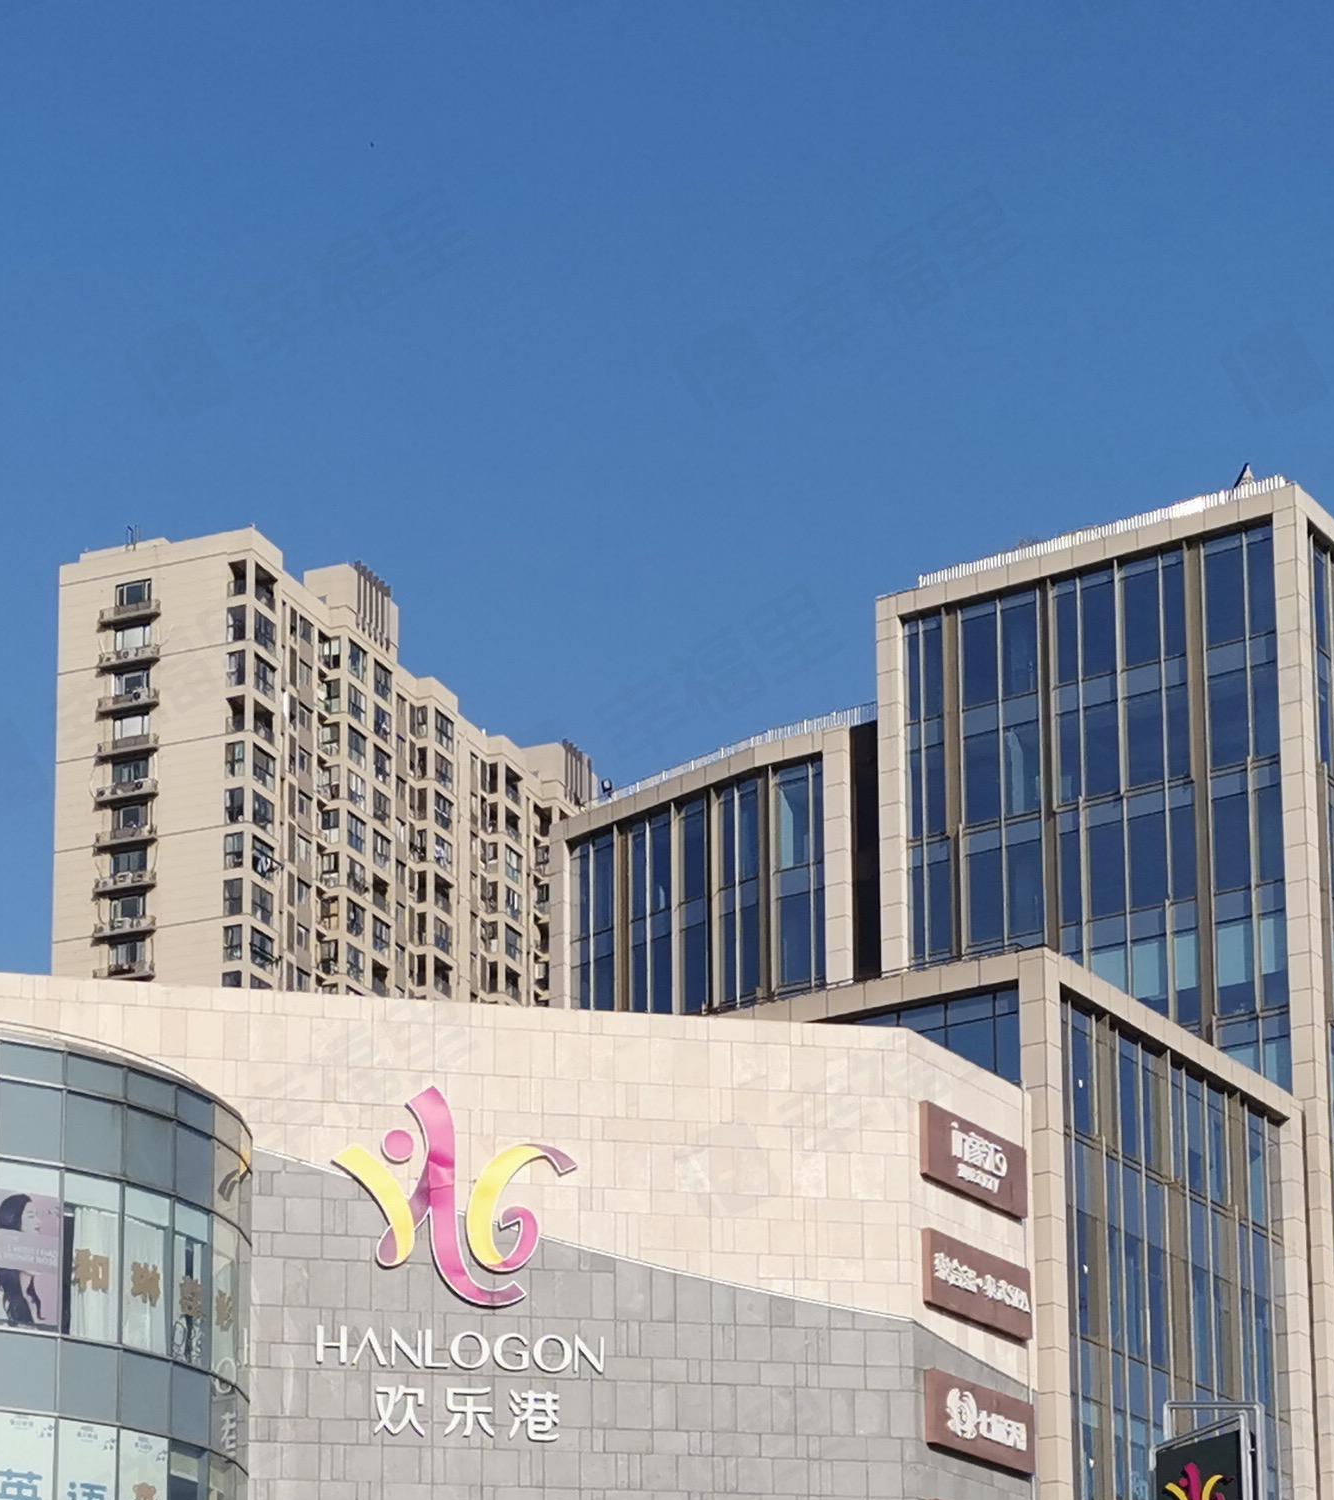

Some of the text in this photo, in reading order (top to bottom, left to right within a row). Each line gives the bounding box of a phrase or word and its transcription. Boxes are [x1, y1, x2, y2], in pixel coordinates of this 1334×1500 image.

[314, 1324, 605, 1375] HANLOGON
[373, 1385, 561, 1442] 欢乐港
